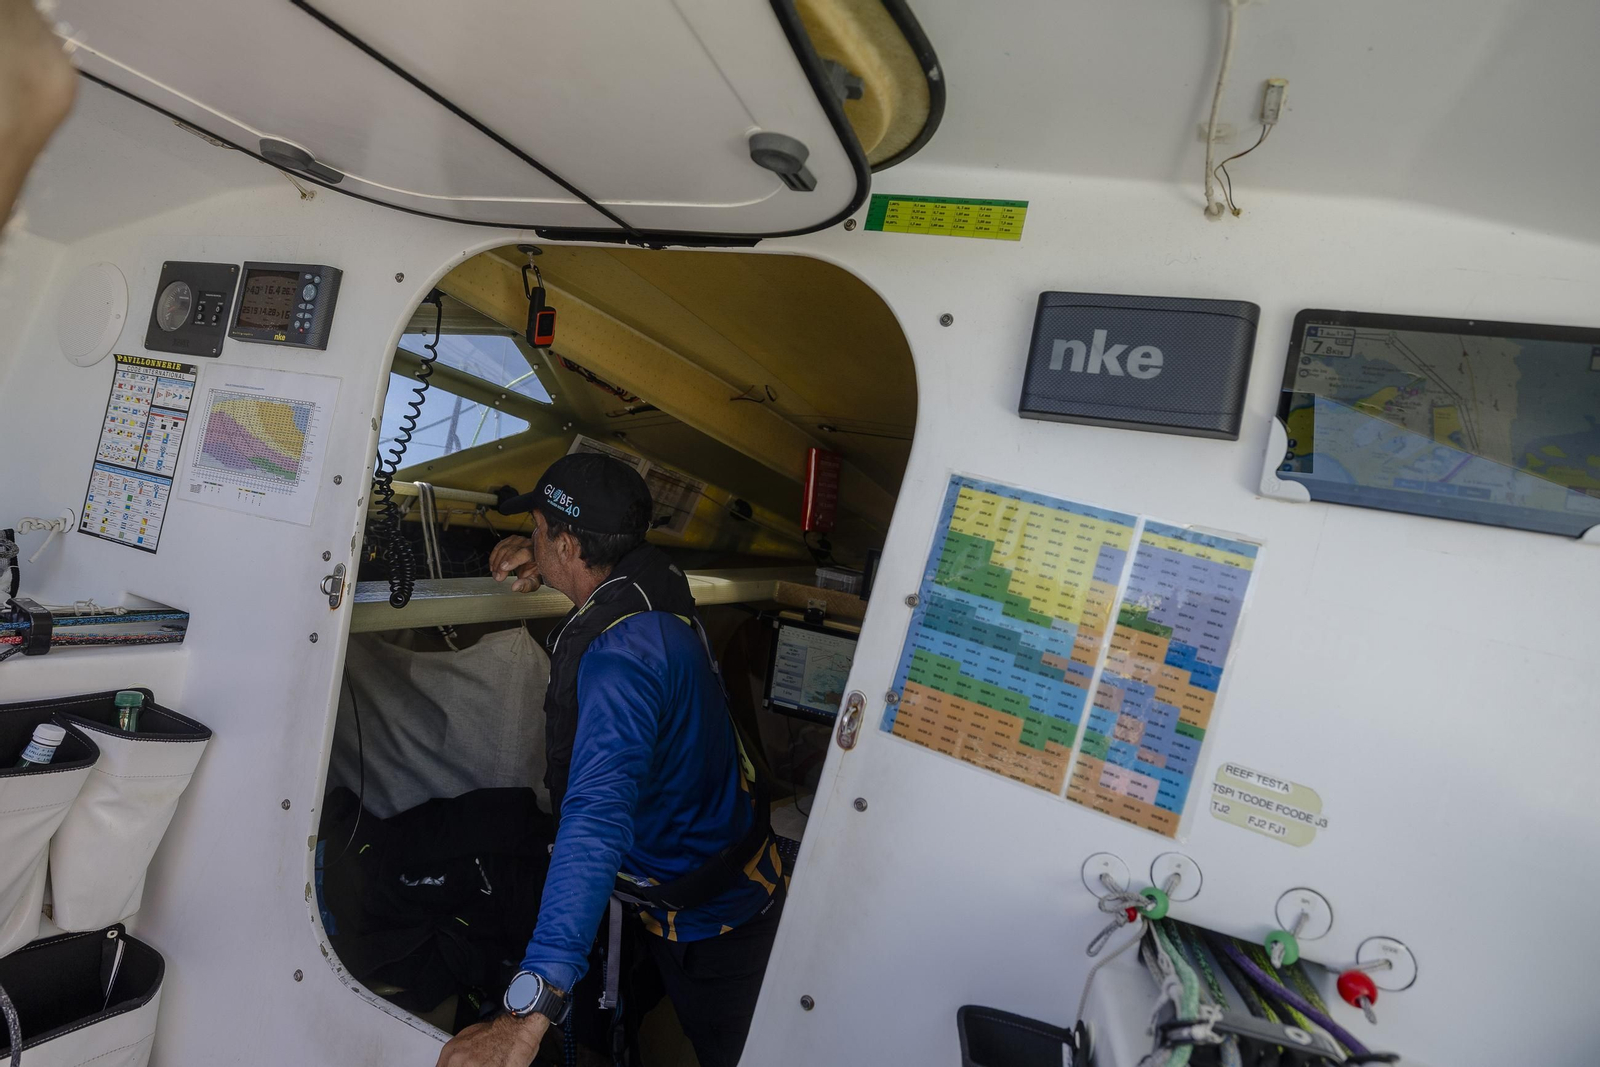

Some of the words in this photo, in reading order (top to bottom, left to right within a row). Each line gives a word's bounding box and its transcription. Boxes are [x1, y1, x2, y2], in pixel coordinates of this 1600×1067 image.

[274, 332, 286, 341] nke
[117, 354, 182, 370] PAVILLONNERIE
[1049, 328, 1164, 380] nke
[143, 368, 185, 379] INTERNATIONAL
[565, 504, 580, 518] 40
[1225, 764, 1254, 780] REEF
[1256, 774, 1289, 792] TESTA
[1212, 783, 1235, 797] TSPI
[1237, 791, 1273, 810] TCODE
[1275, 804, 1313, 823] FCODE
[1315, 818, 1328, 828] J3
[1212, 801, 1230, 814] TJ2
[1248, 816, 1267, 829] FJ2
[1268, 822, 1286, 836] FJ1
